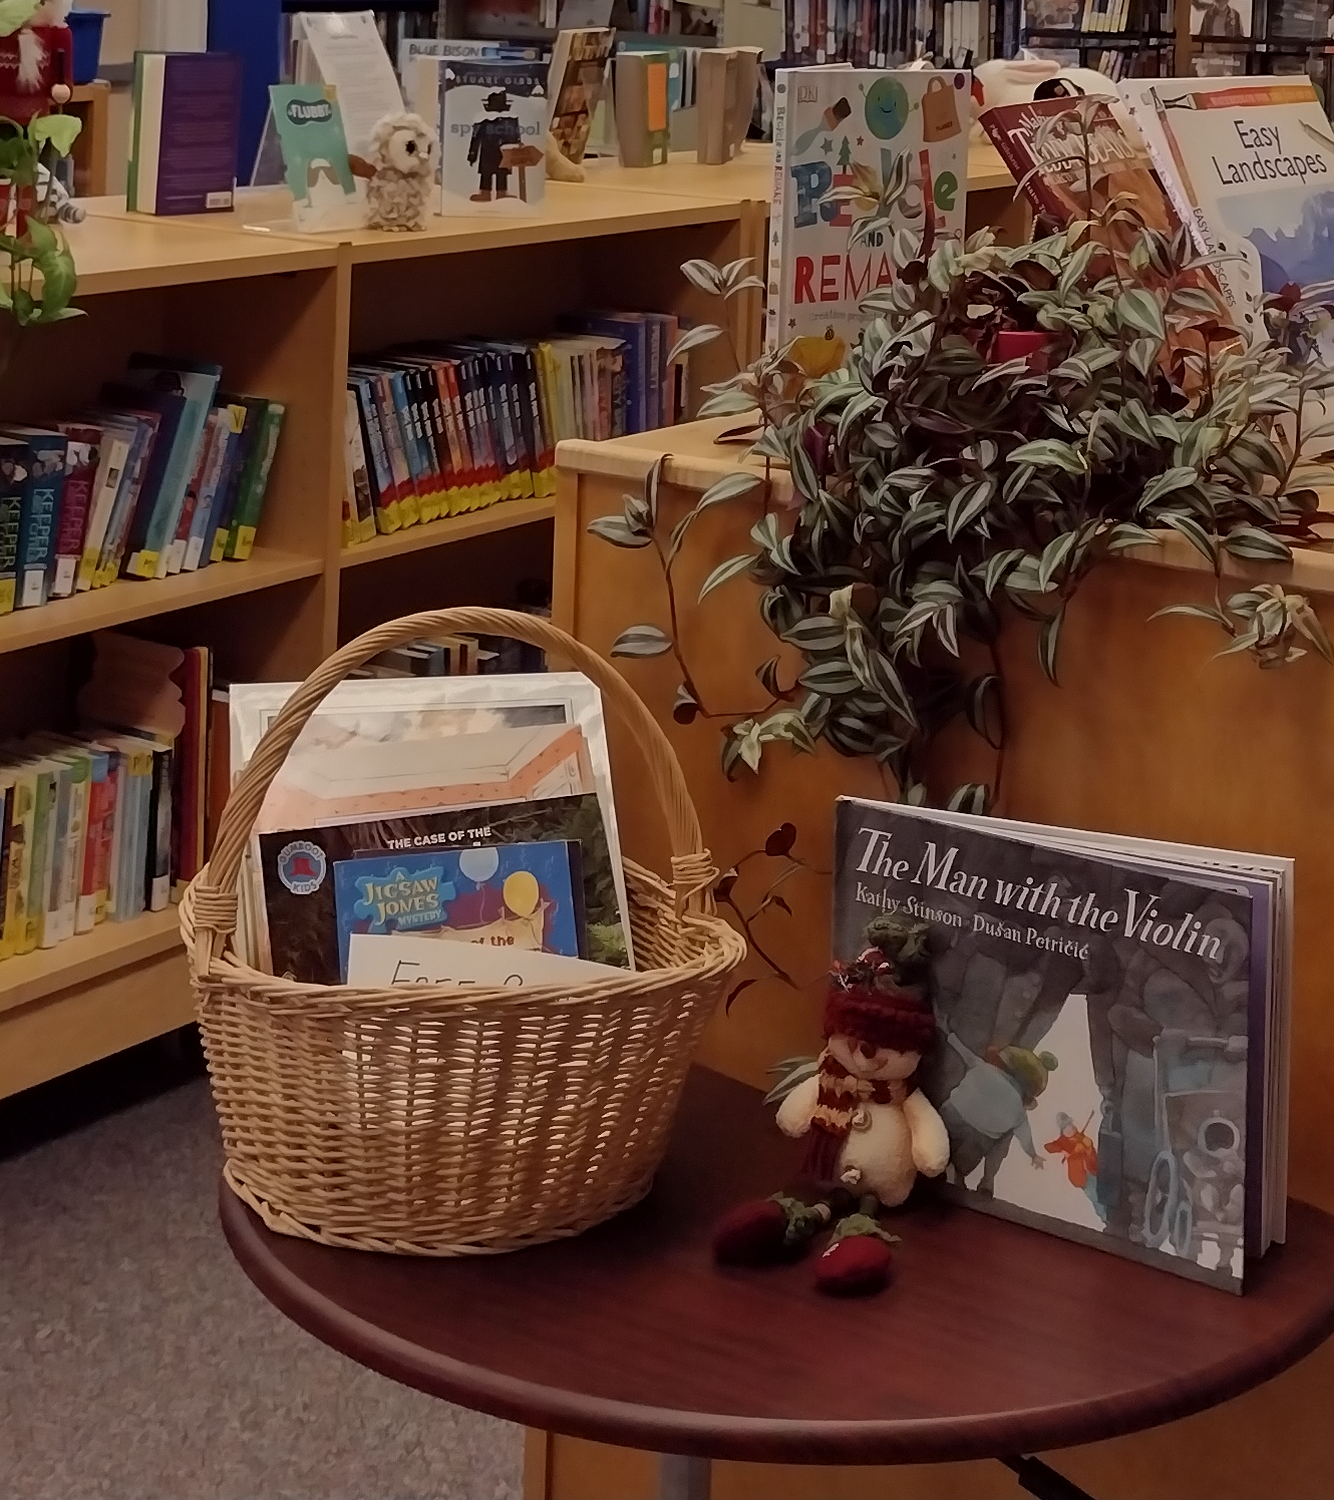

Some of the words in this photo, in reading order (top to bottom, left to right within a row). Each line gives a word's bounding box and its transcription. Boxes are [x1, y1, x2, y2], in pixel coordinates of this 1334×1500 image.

[409, 43, 440, 56] BLUE
[442, 44, 481, 58] BISON
[455, 75, 499, 86] STUART
[504, 76, 542, 86] GIBBS
[291, 103, 330, 120] FLUBBY
[485, 120, 542, 136] school
[1233, 119, 1282, 155] Easy
[1211, 151, 1328, 185] Landscapes
[1193, 207, 1210, 234] EASY
[1203, 232, 1237, 308] LADSCAPES
[387, 838, 412, 851] THE
[413, 834, 447, 847] CASE
[448, 831, 465, 843] OF
[466, 826, 492, 840] THE
[278, 840, 325, 864] GUMBOOT
[292, 880, 320, 893] KIDS
[363, 875, 441, 906] JIGSAW
[855, 827, 910, 882] The
[911, 840, 986, 901] Man
[995, 876, 1063, 919] with
[1066, 891, 1120, 934] the
[1122, 887, 1223, 960] Violin
[376, 894, 440, 925] JONES
[397, 910, 443, 927] MYSTERY
[855, 881, 902, 915] Kathy
[903, 895, 963, 928] Stinson
[972, 913, 1023, 944] Dušan
[1024, 928, 1091, 961] Petričić
[491, 934, 515, 947] the
